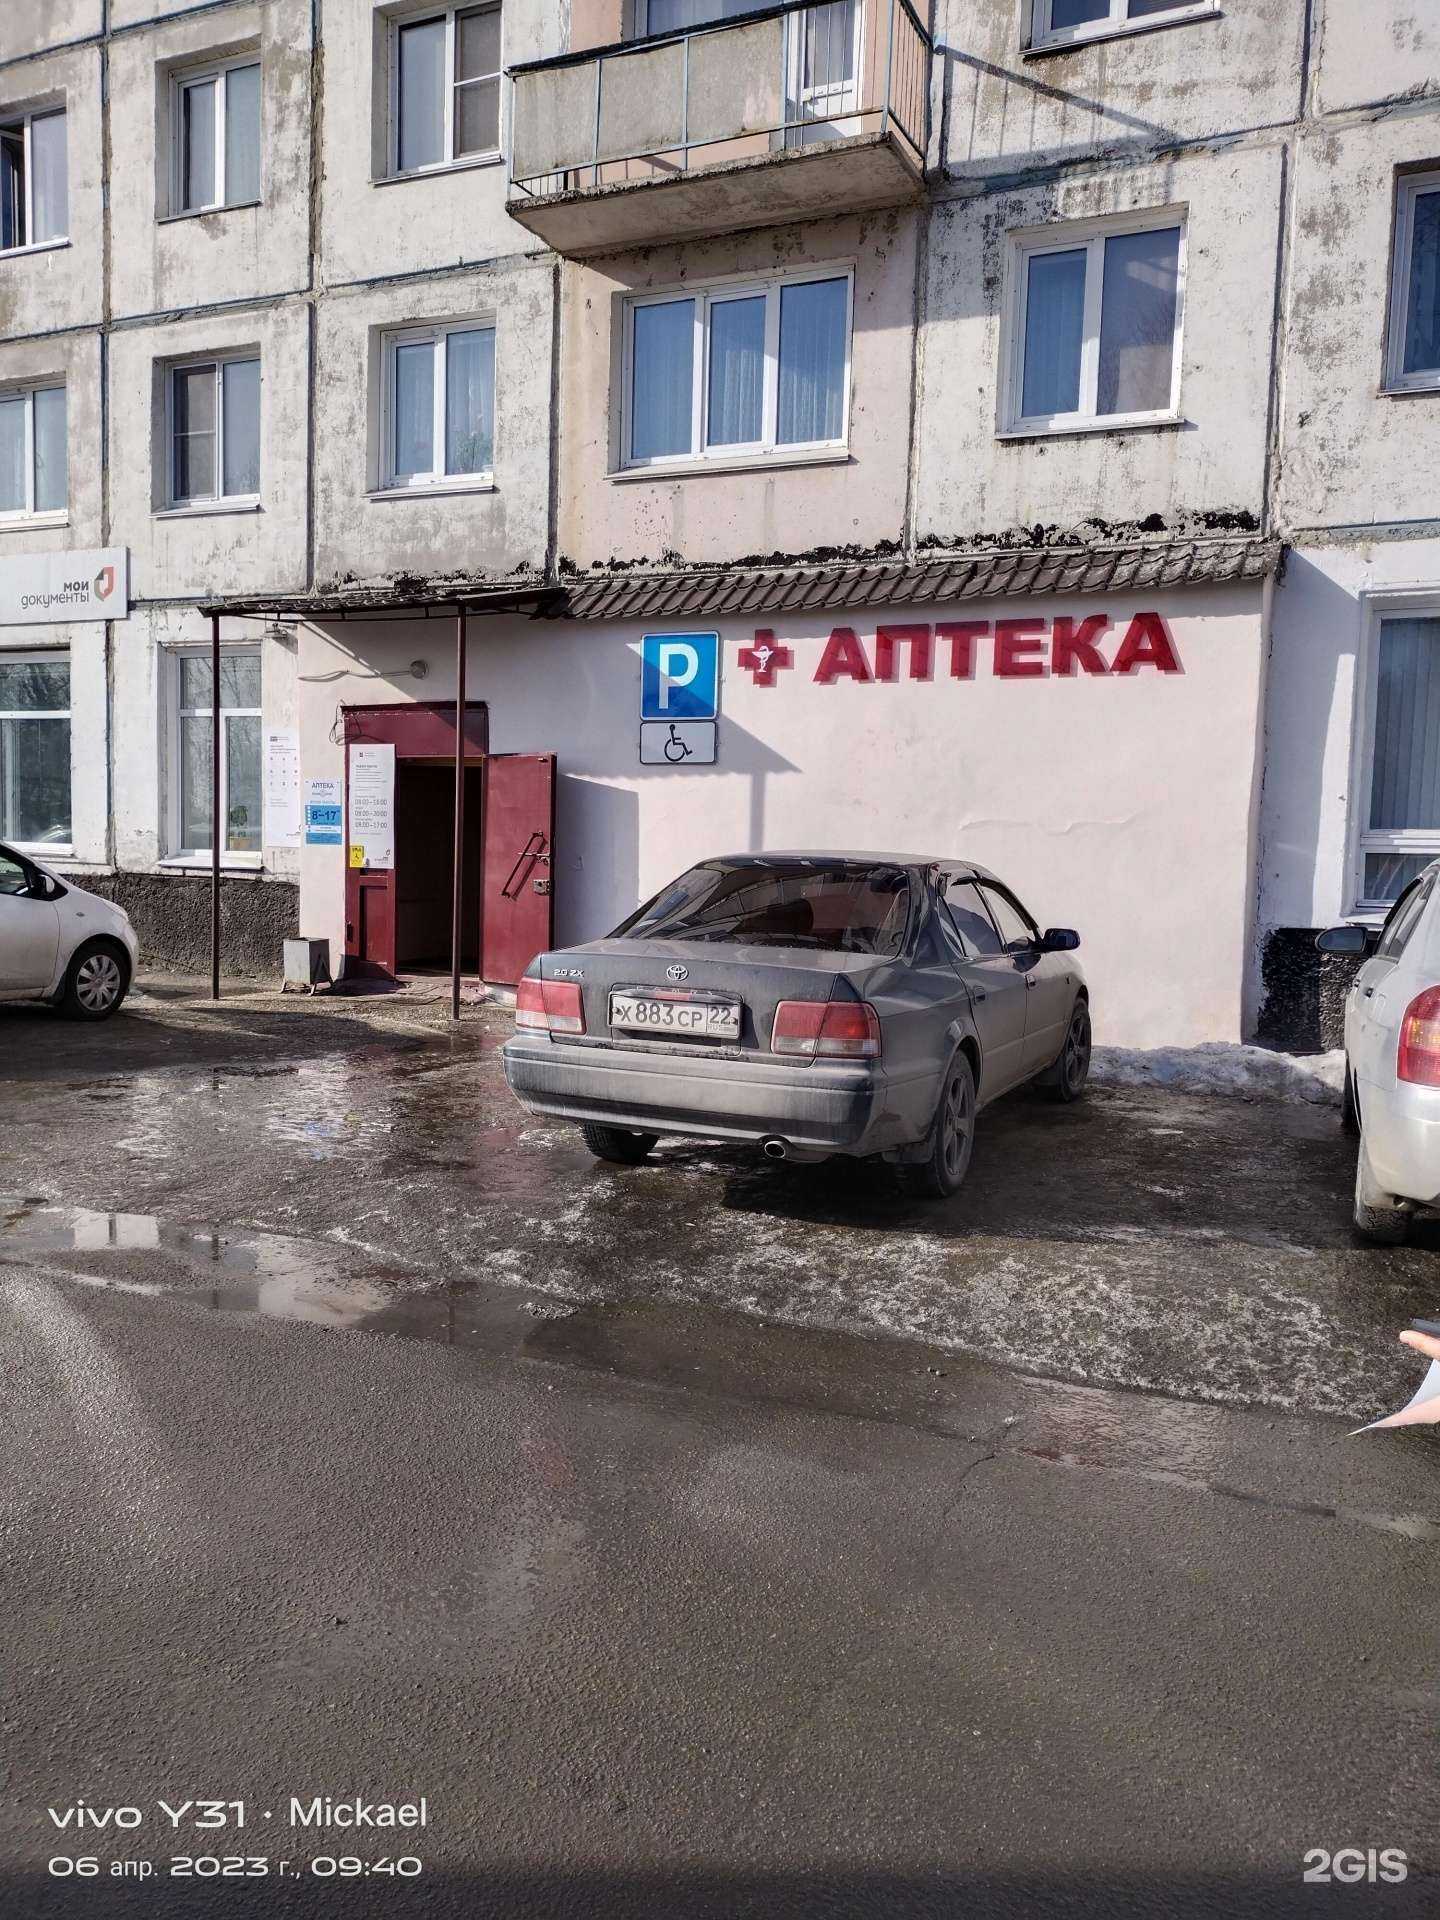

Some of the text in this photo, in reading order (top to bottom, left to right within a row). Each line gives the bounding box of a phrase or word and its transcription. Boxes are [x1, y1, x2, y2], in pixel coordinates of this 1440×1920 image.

[21, 592, 89, 609] документы
[813, 612, 1180, 684] АПТЕКА
[658, 642, 699, 710] P
[311, 782, 335, 790] АПТЕКА
